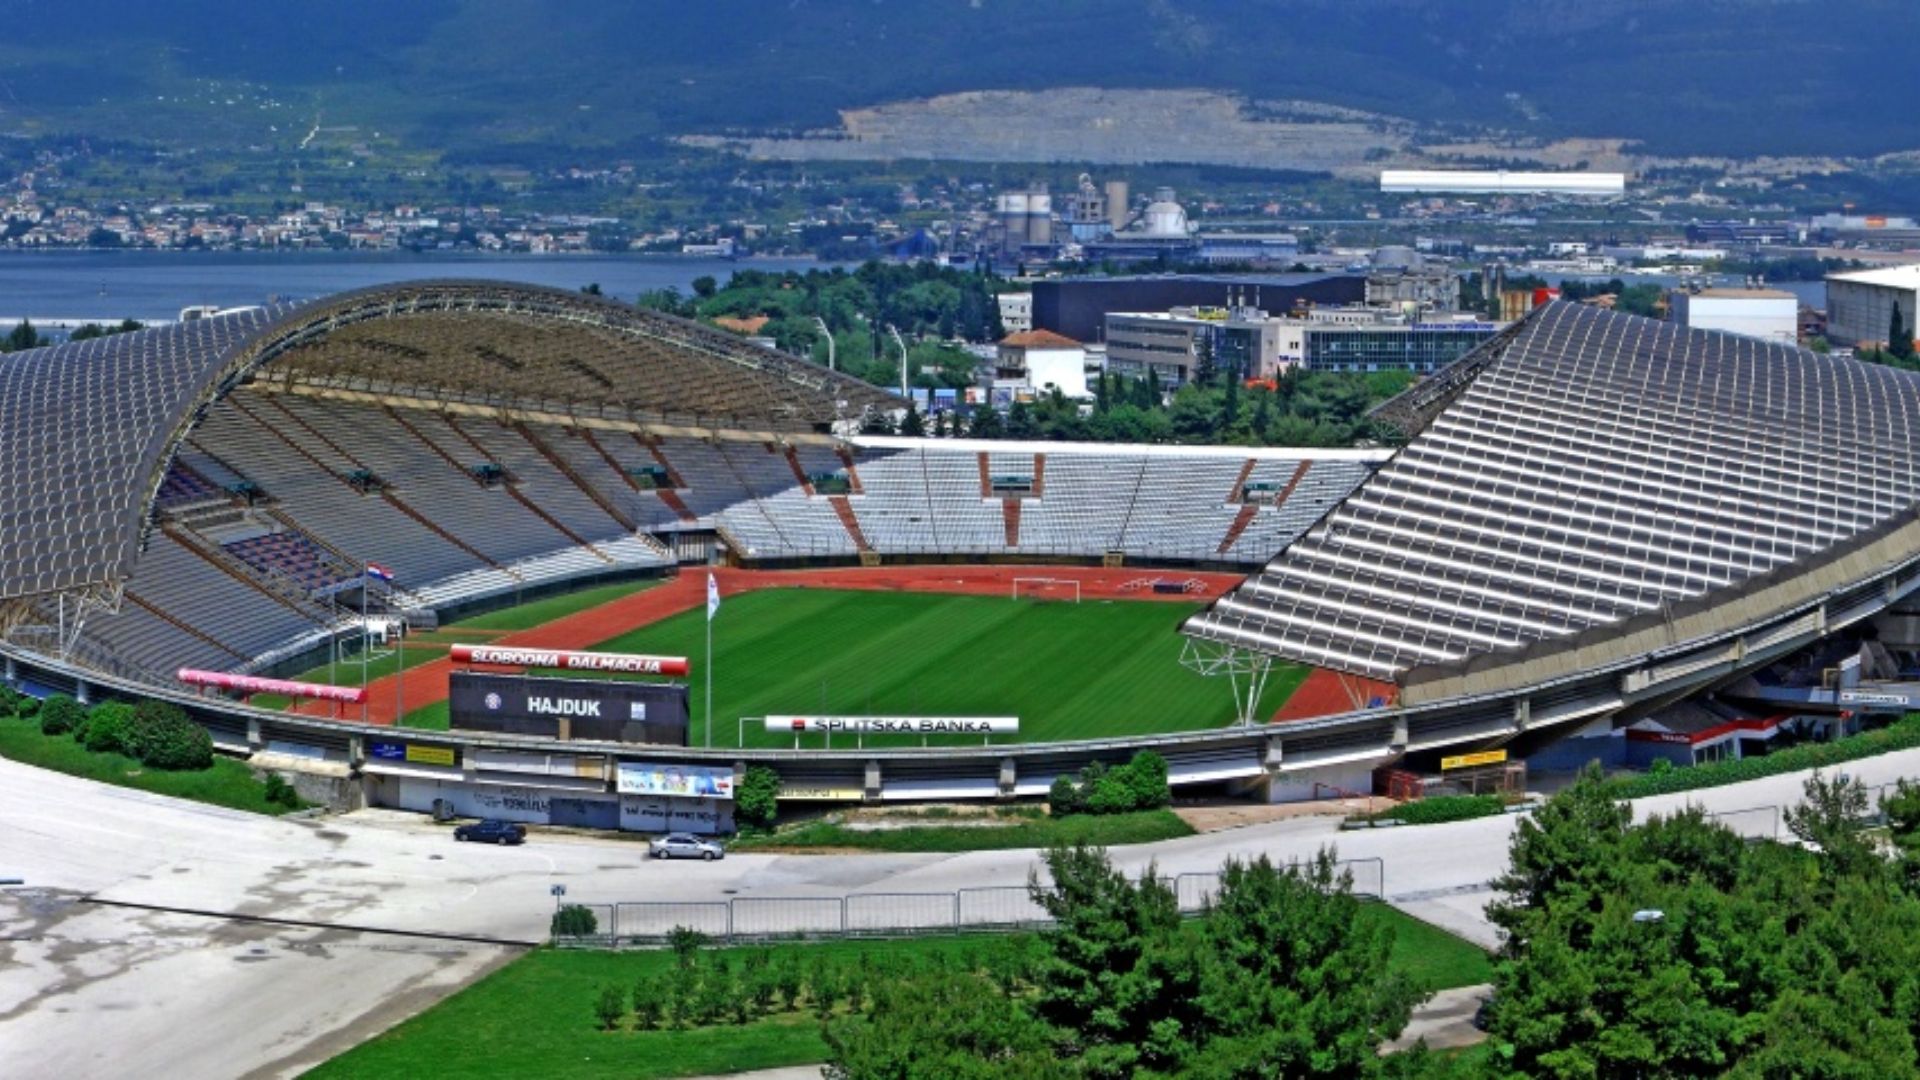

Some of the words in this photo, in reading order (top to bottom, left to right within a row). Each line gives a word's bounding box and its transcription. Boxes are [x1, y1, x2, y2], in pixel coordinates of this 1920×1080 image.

[471, 650, 559, 667] SLOBODNA
[568, 655, 661, 672] DALMACIJA
[528, 697, 601, 716] HAJDUK
[815, 719, 913, 732] SPLITSKA
[919, 720, 992, 732] BANKA
